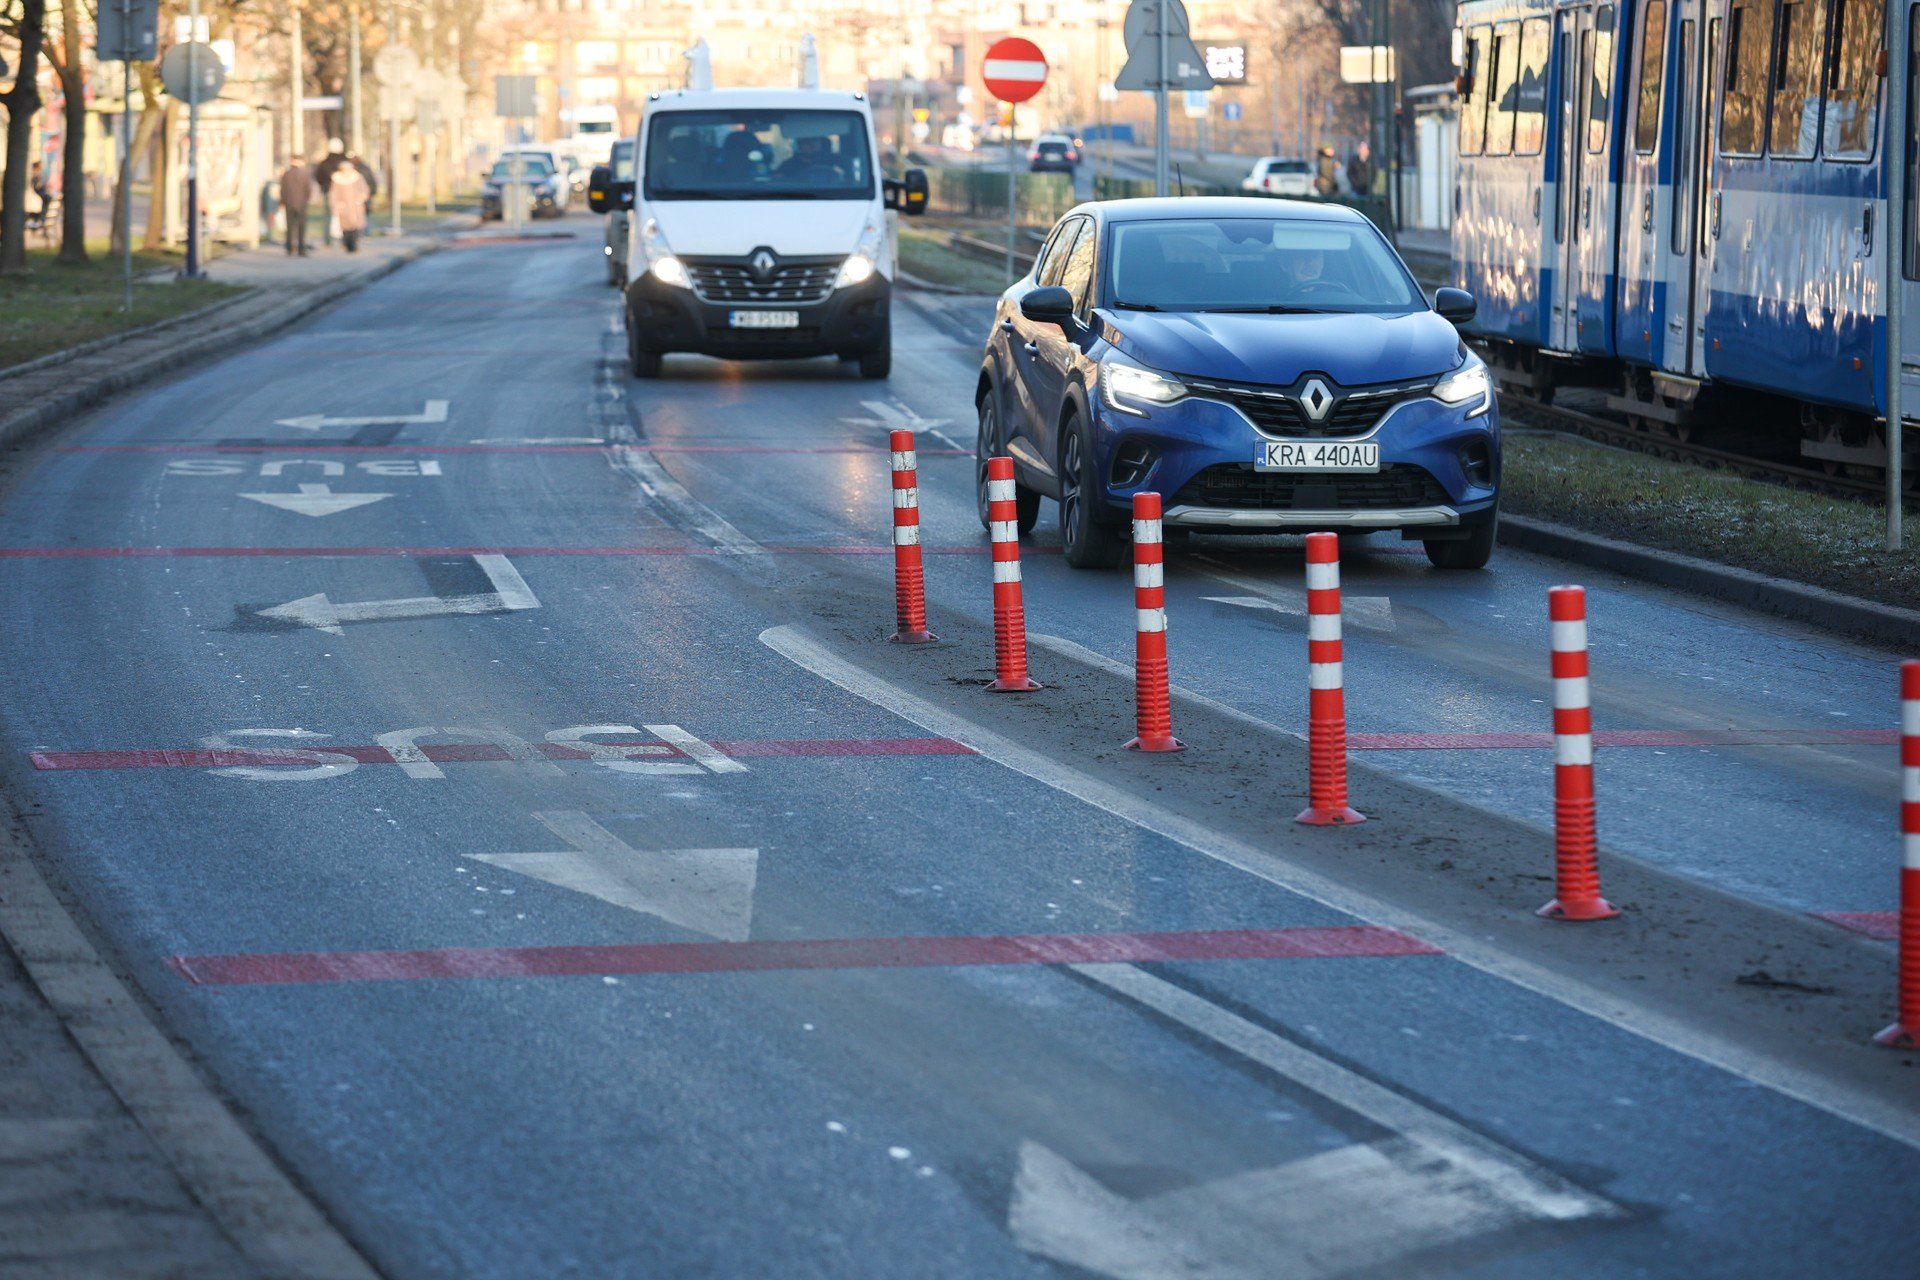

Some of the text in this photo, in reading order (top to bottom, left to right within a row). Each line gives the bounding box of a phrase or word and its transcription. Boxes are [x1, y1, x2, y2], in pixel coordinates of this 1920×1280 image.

[1267, 444, 1376, 466] KRA 440AU
[168, 459, 442, 477] BUS
[203, 724, 748, 780] BUS
